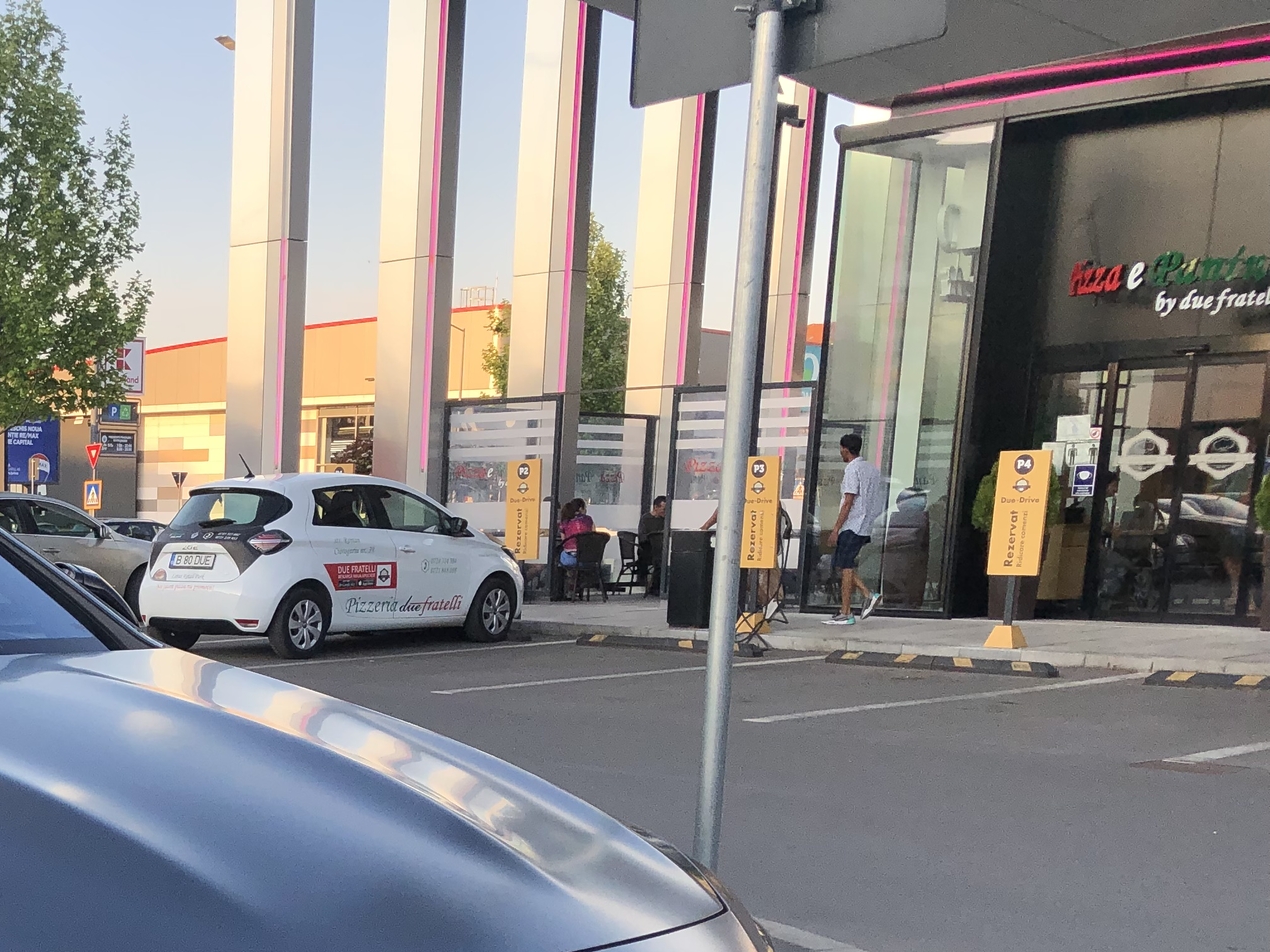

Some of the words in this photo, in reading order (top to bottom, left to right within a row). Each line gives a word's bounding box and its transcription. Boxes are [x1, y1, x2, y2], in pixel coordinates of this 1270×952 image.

[1126, 261, 1145, 290] e
[1155, 290, 1176, 317] by
[519, 467, 529, 475] P2
[753, 464, 765, 473] P3
[1017, 459, 1031, 470] P4
[514, 508, 523, 554] Rezervat
[747, 510, 757, 561] Rezervat
[1003, 509, 1019, 567] Rezervat
[176, 555, 182, 565] B
[184, 555, 194, 565] 80
[194, 555, 211, 566] DUE
[1016, 541, 1024, 568] Ridicare
[337, 566, 350, 574] DUE
[351, 564, 376, 573] FRATELLI
[345, 596, 398, 614] Pizzeria
